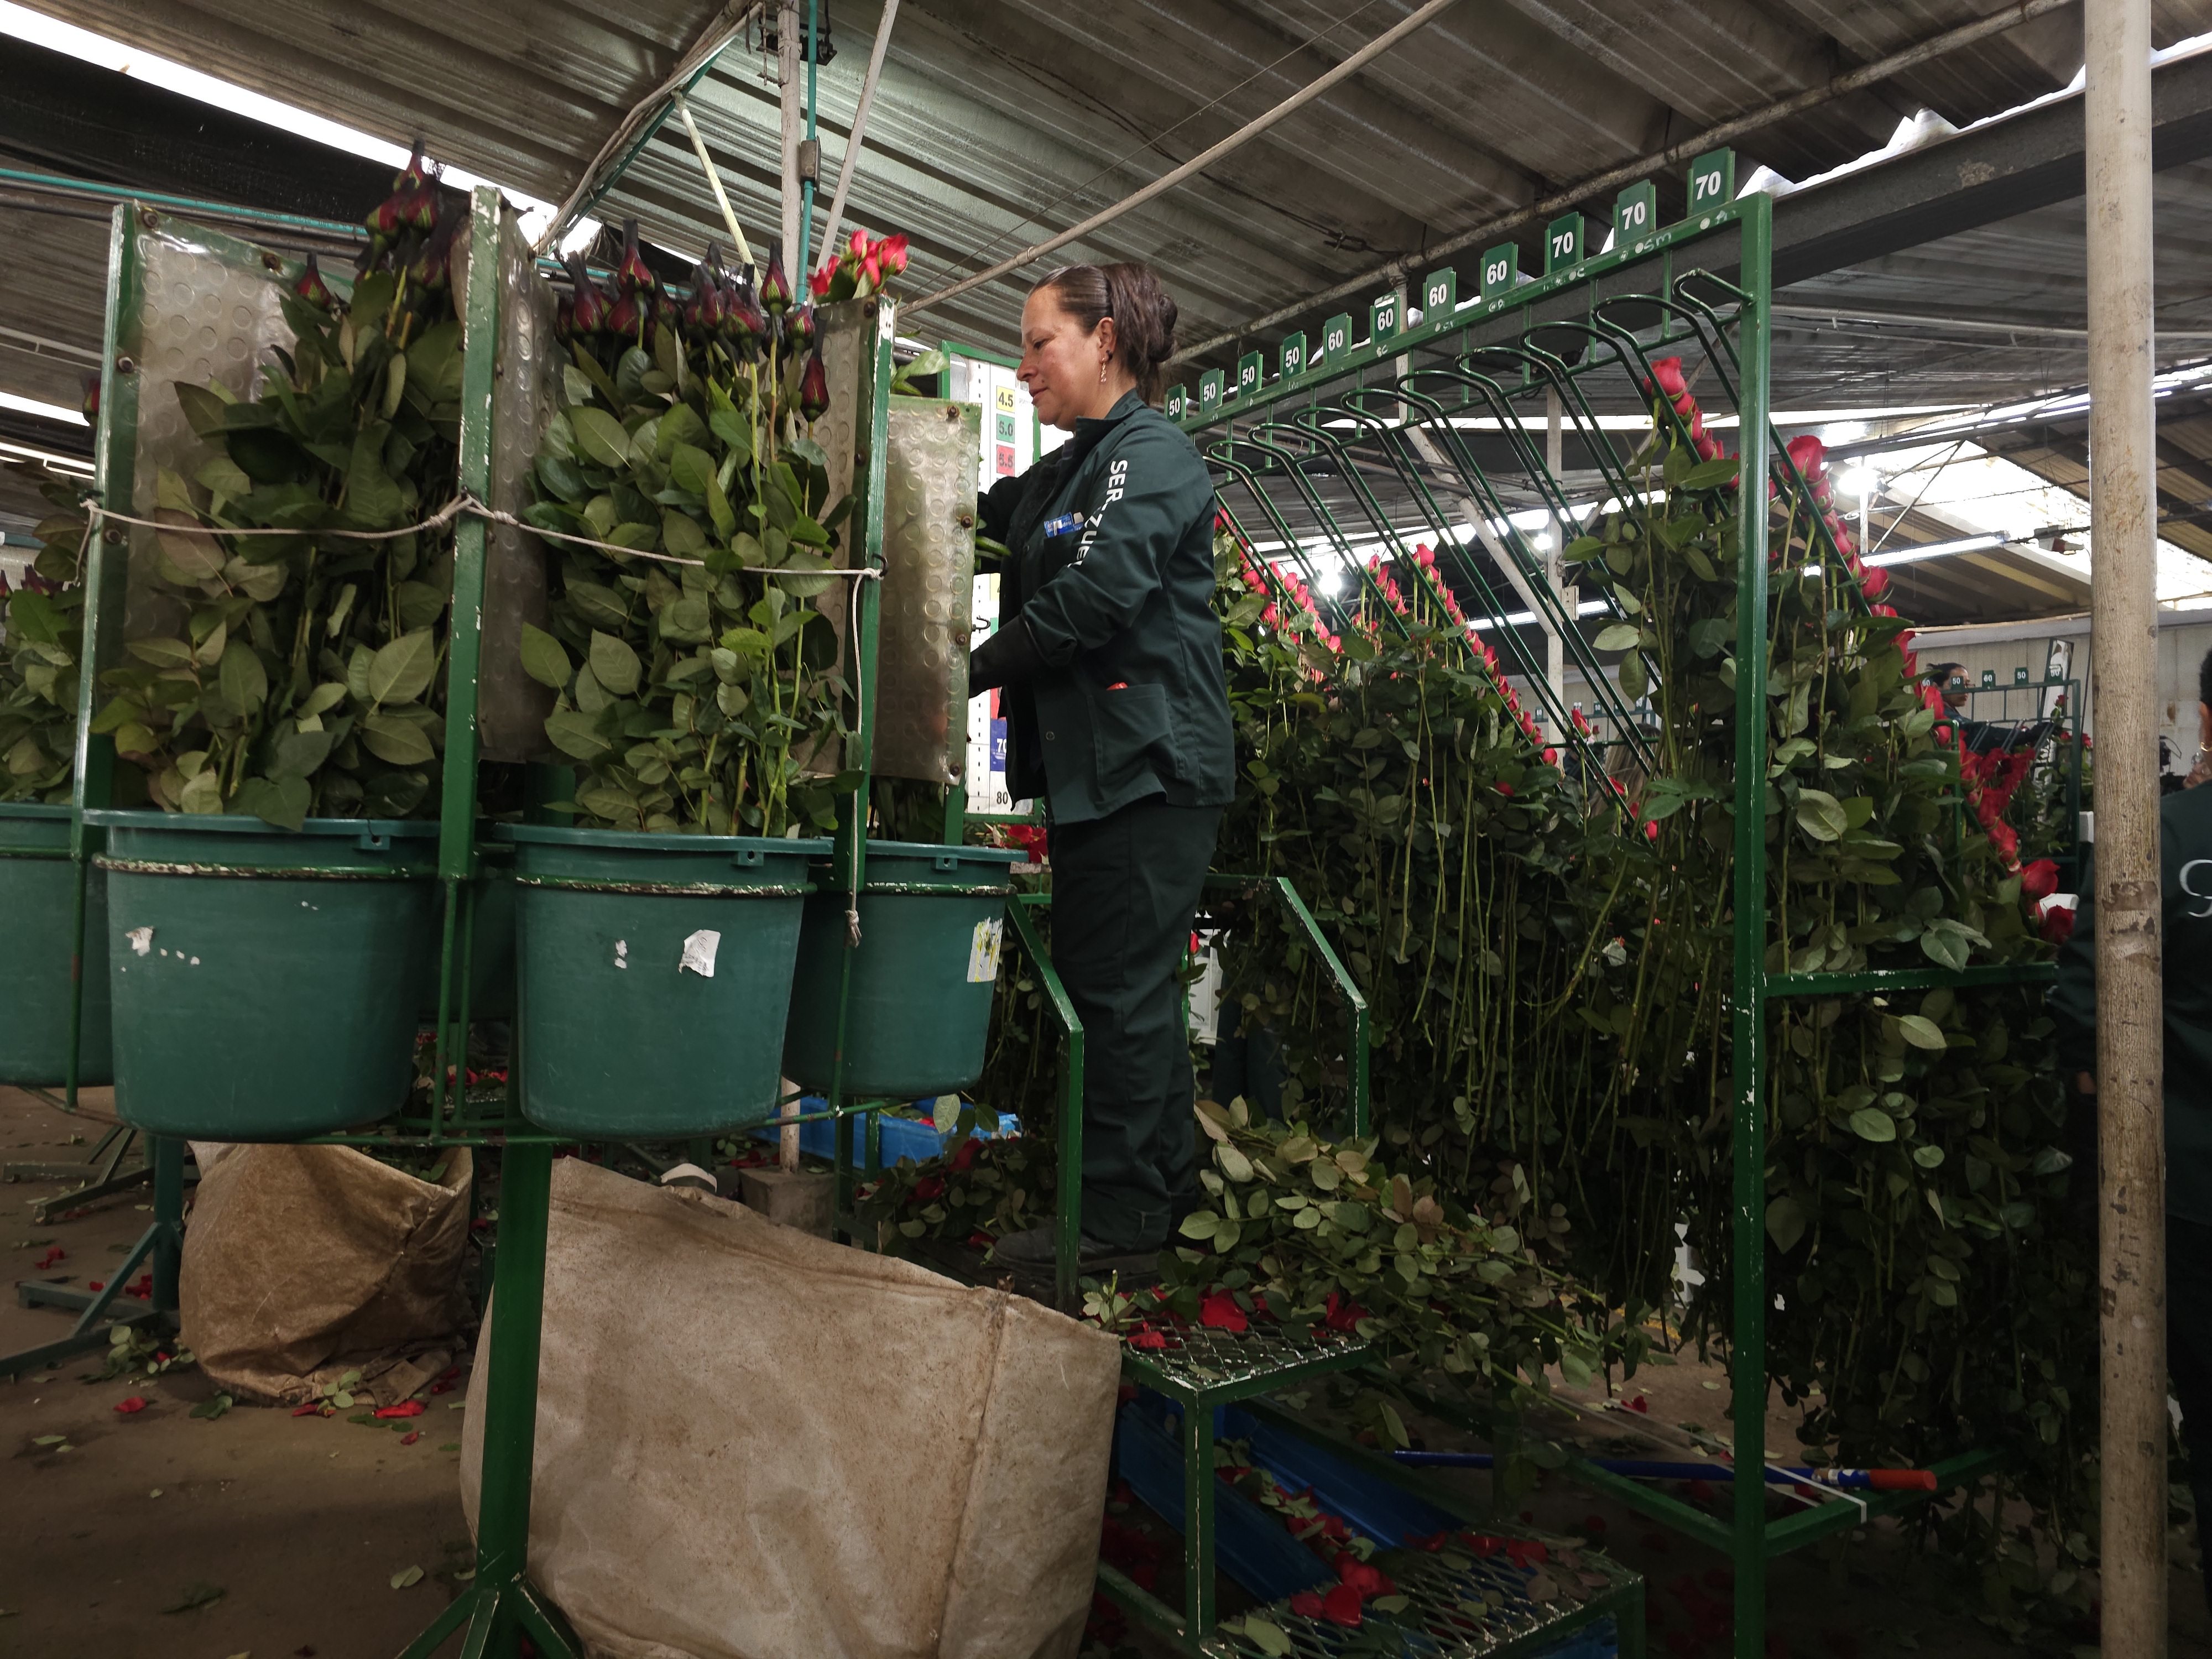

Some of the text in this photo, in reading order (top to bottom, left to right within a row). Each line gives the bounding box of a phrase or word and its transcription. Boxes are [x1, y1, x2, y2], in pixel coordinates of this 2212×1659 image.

[1695, 171, 1721, 200] 70
[1622, 201, 1645, 230] 70
[1552, 231, 1573, 258] 70
[1487, 260, 1507, 285] 60
[1429, 283, 1447, 307] 60
[1378, 307, 1394, 331] 60
[1328, 329, 1343, 351] 60
[1286, 346, 1300, 366] 50
[1242, 366, 1255, 386] 50
[998, 392, 1014, 408] 4.5
[1203, 382, 1215, 402] 50
[1169, 397, 1181, 416] 50
[999, 420, 1014, 436] 5.0
[999, 452, 1014, 468] 5.5
[997, 791, 1008, 804] 80
